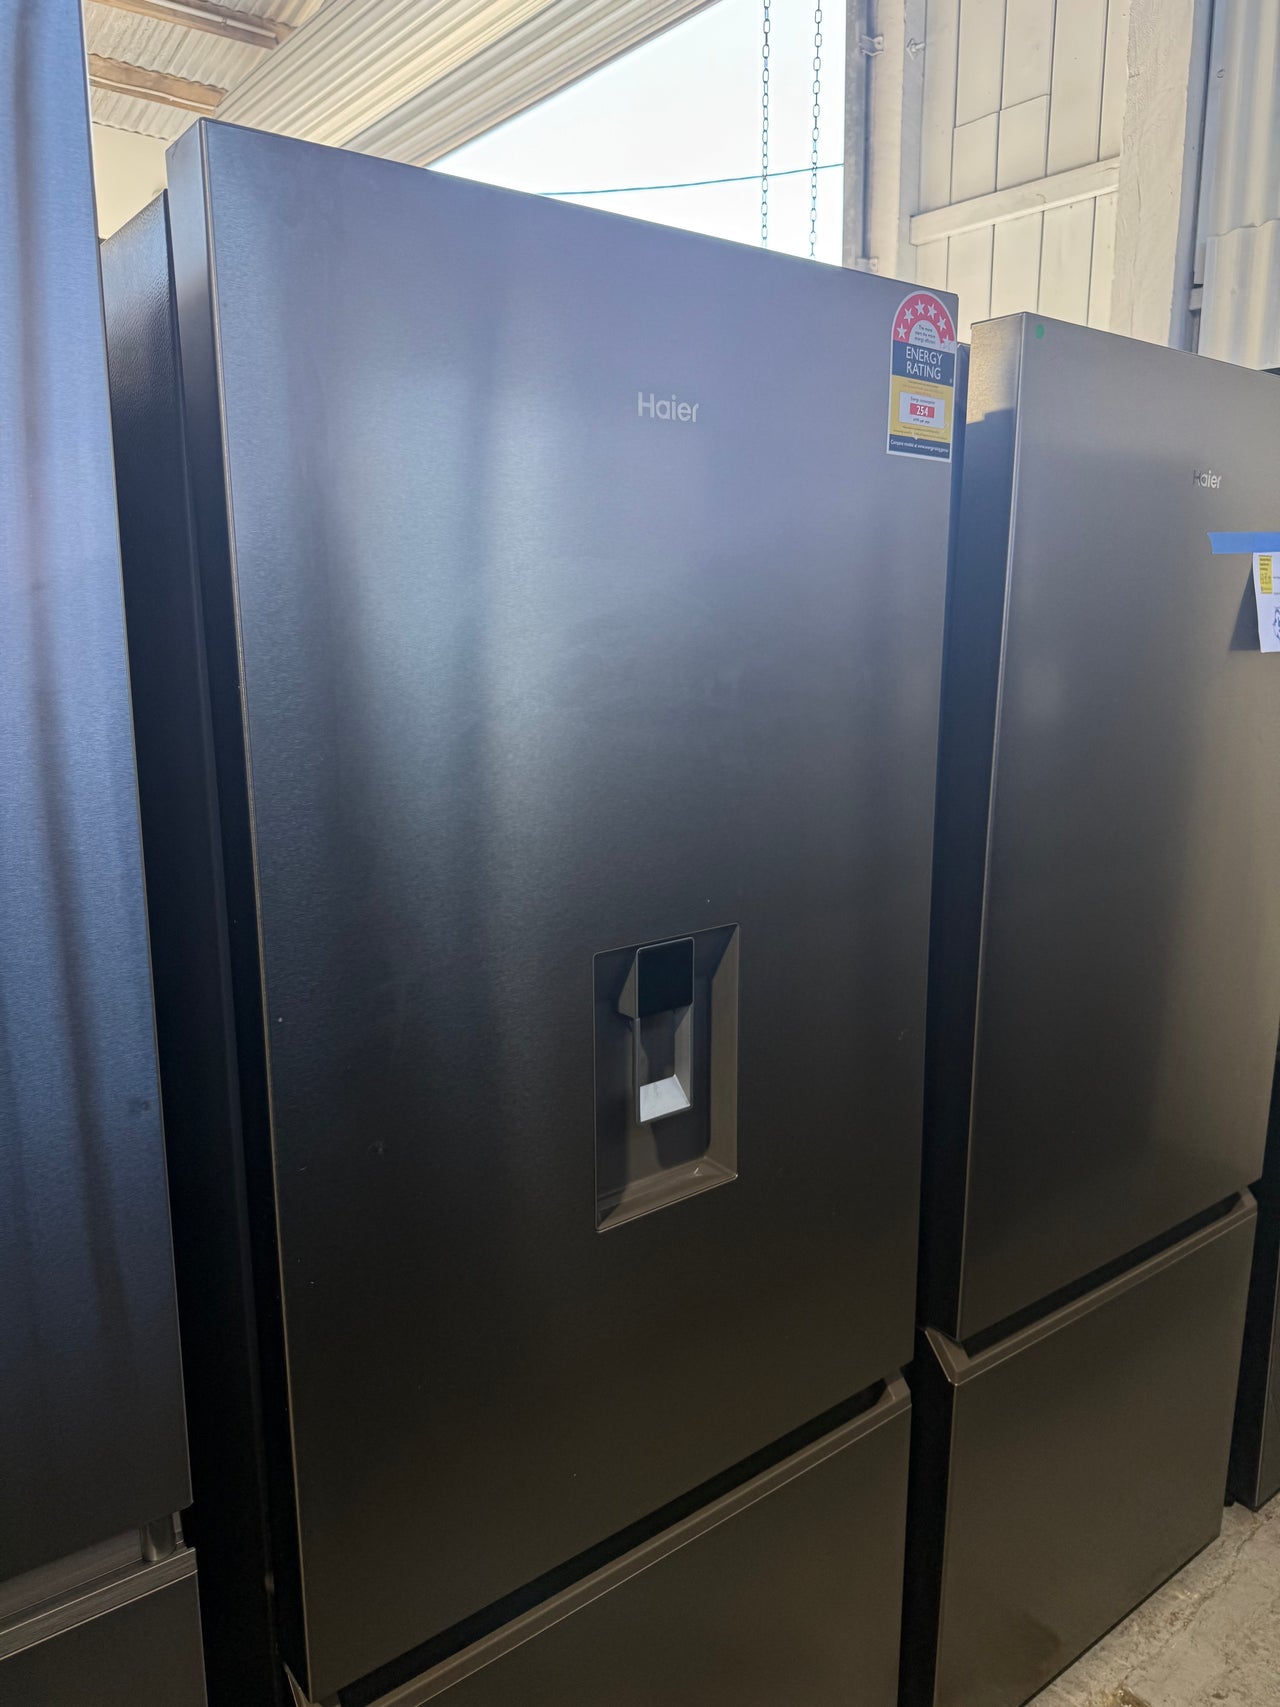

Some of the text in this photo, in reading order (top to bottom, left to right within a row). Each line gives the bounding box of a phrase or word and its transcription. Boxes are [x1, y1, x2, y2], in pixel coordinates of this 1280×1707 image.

[905, 346, 943, 366] ENERGY
[906, 361, 941, 380] RATING
[637, 391, 700, 423] Haier
[916, 405, 929, 417] 254
[1192, 468, 1223, 489] Haier
